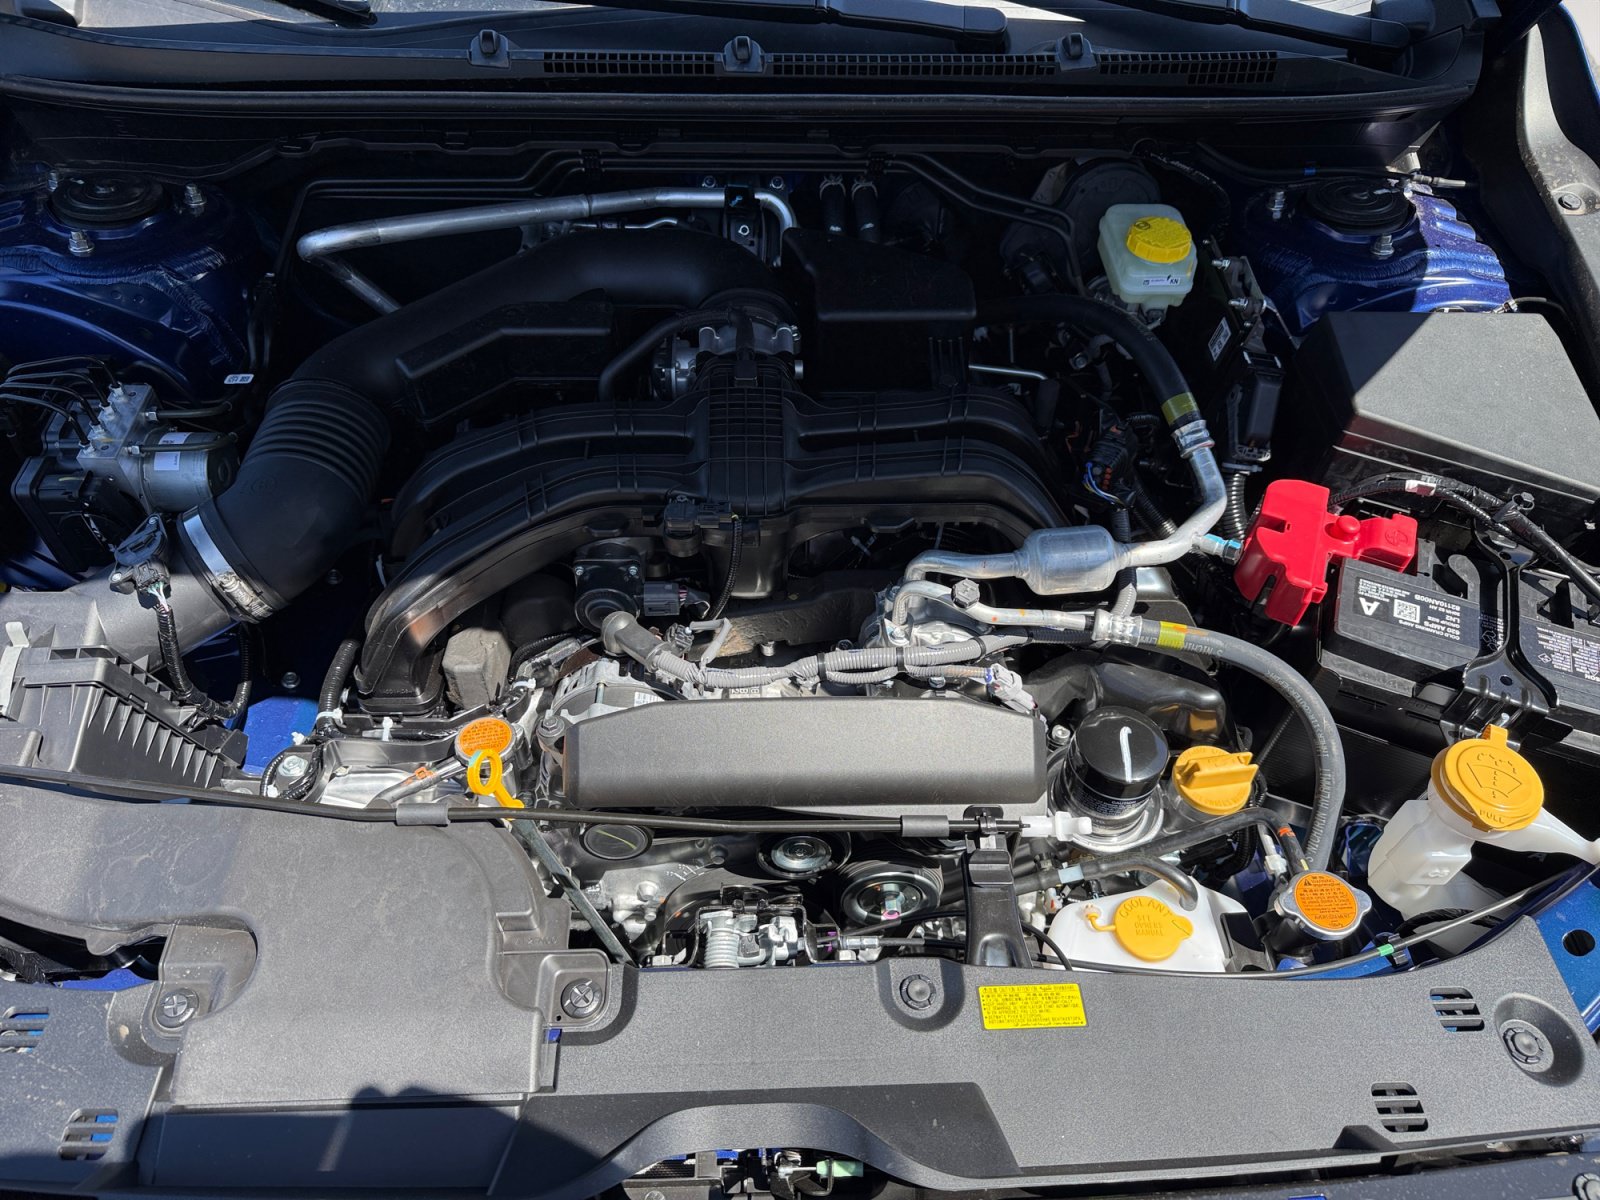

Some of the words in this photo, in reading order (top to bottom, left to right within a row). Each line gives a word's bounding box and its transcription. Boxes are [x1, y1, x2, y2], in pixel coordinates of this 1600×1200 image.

[1423, 620, 1446, 631] AMPS
[1479, 809, 1505, 824] PULL
[1120, 898, 1174, 918] COOLANT
